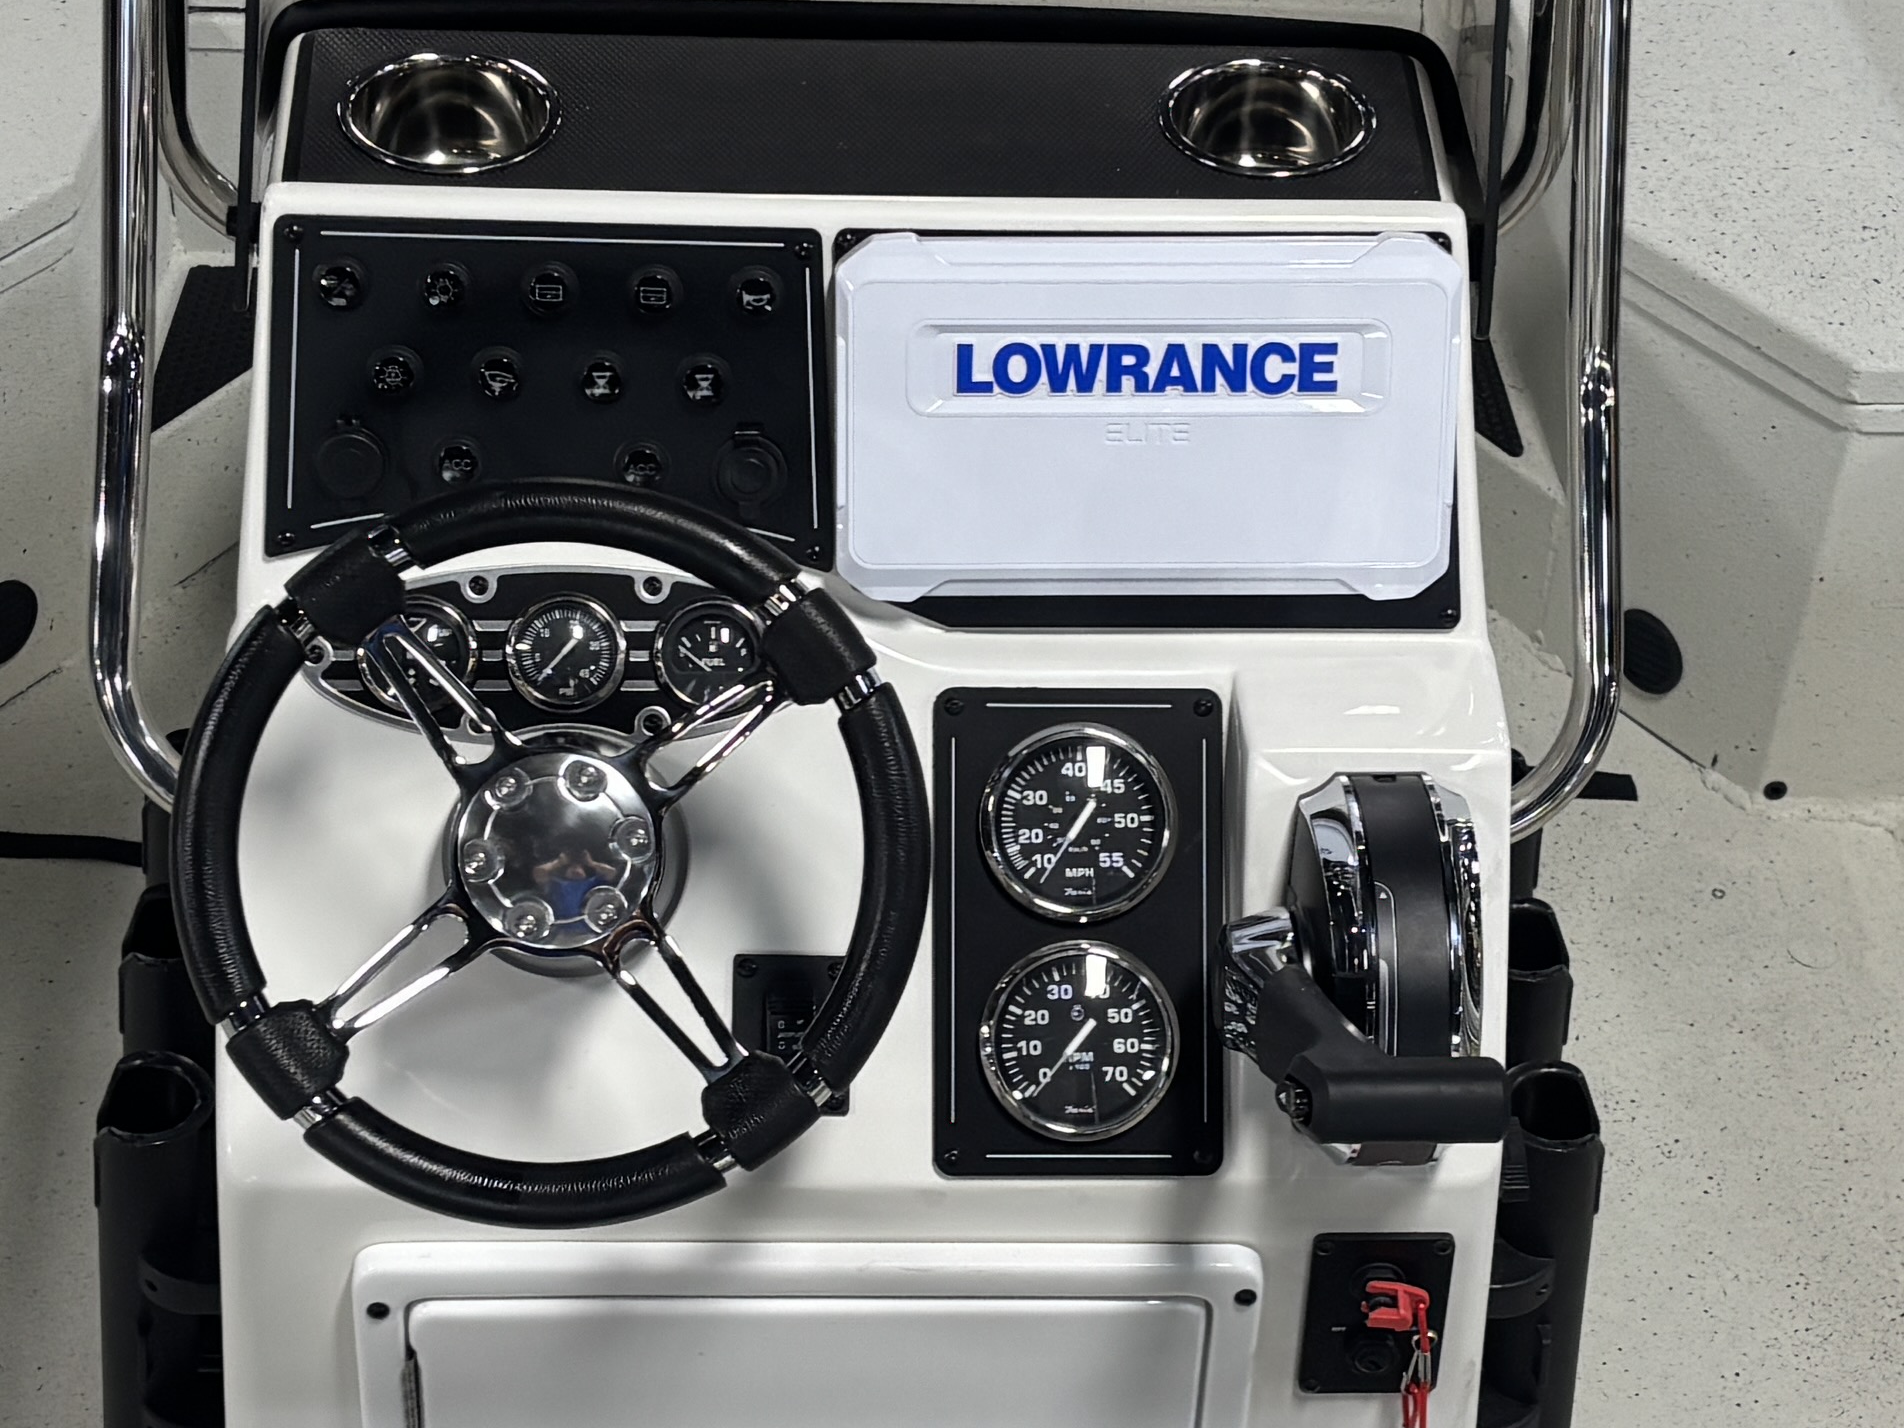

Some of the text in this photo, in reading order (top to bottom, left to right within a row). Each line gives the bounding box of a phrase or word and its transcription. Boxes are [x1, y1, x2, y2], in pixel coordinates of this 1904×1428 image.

[955, 342, 1338, 395] LOWRANCE
[1104, 422, 1191, 444] ELITE
[1061, 762, 1086, 777] 40
[1099, 779, 1125, 794] 45
[1022, 790, 1048, 805] 30
[1114, 813, 1139, 828] 50
[1018, 828, 1044, 843] 20
[1032, 853, 1056, 868] 10
[1099, 852, 1124, 867] 55
[1065, 868, 1094, 877] MPH
[1047, 984, 1073, 999] 30
[1023, 1009, 1049, 1025] 20
[1107, 1008, 1133, 1023] 50
[1017, 1040, 1042, 1055] 10
[1113, 1038, 1139, 1053] 60
[1038, 1068, 1051, 1082] 0
[1102, 1066, 1128, 1081] 70
